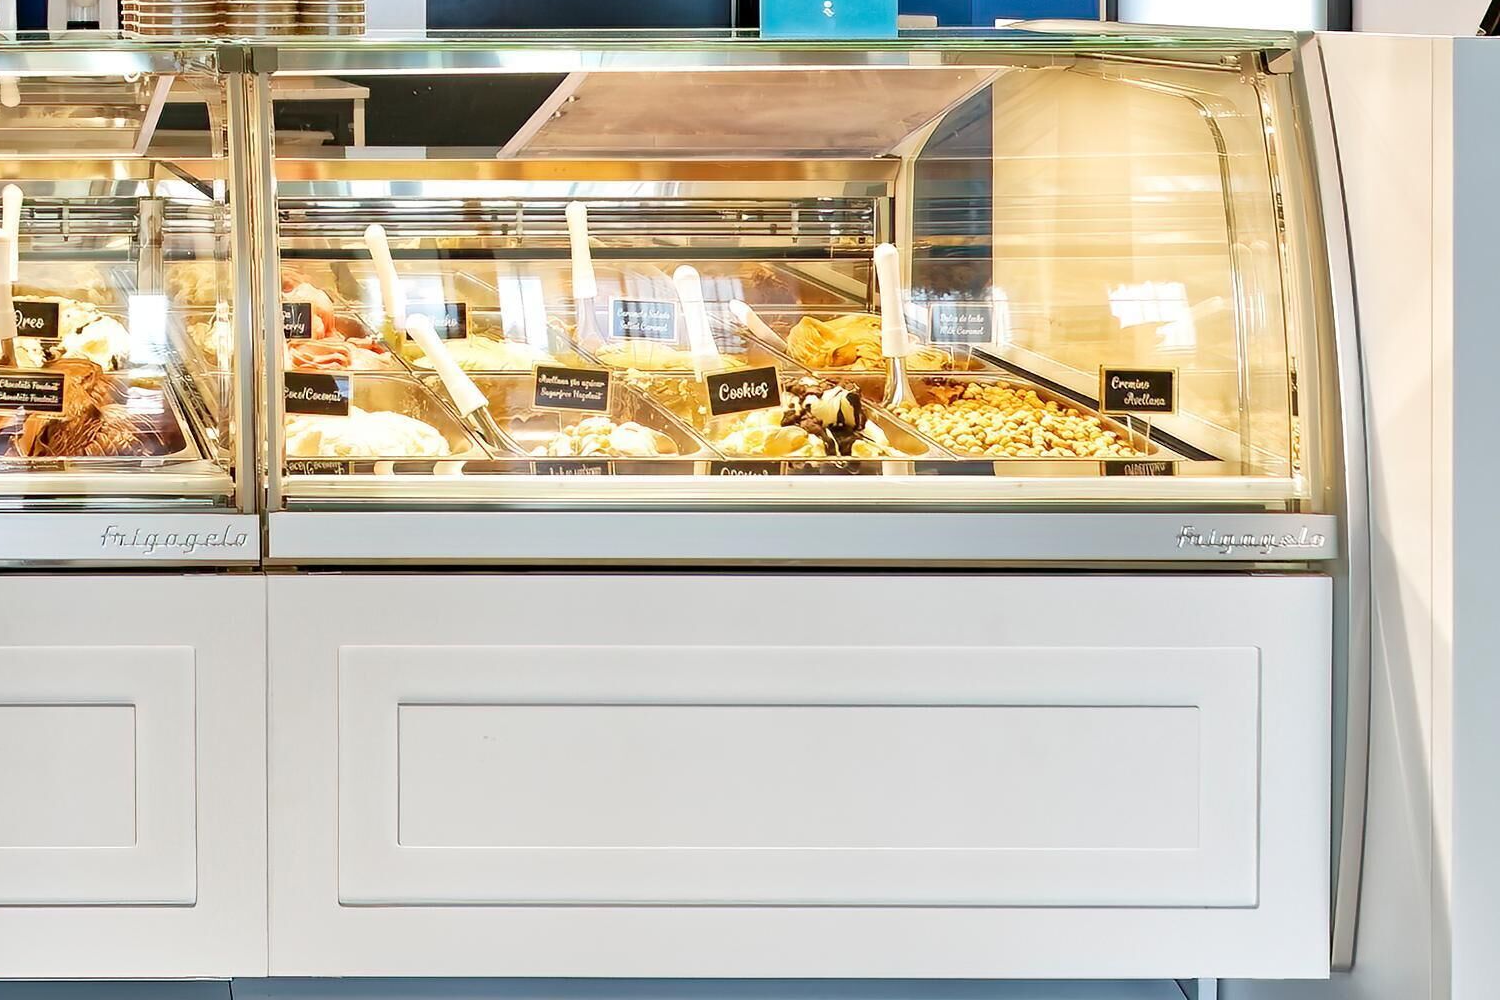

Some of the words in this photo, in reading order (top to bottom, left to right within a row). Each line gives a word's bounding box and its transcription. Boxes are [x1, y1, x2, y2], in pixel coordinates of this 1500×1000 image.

[13, 309, 45, 330] Oreo
[719, 382, 769, 402] Cookies
[1123, 391, 1166, 406] Avellana
